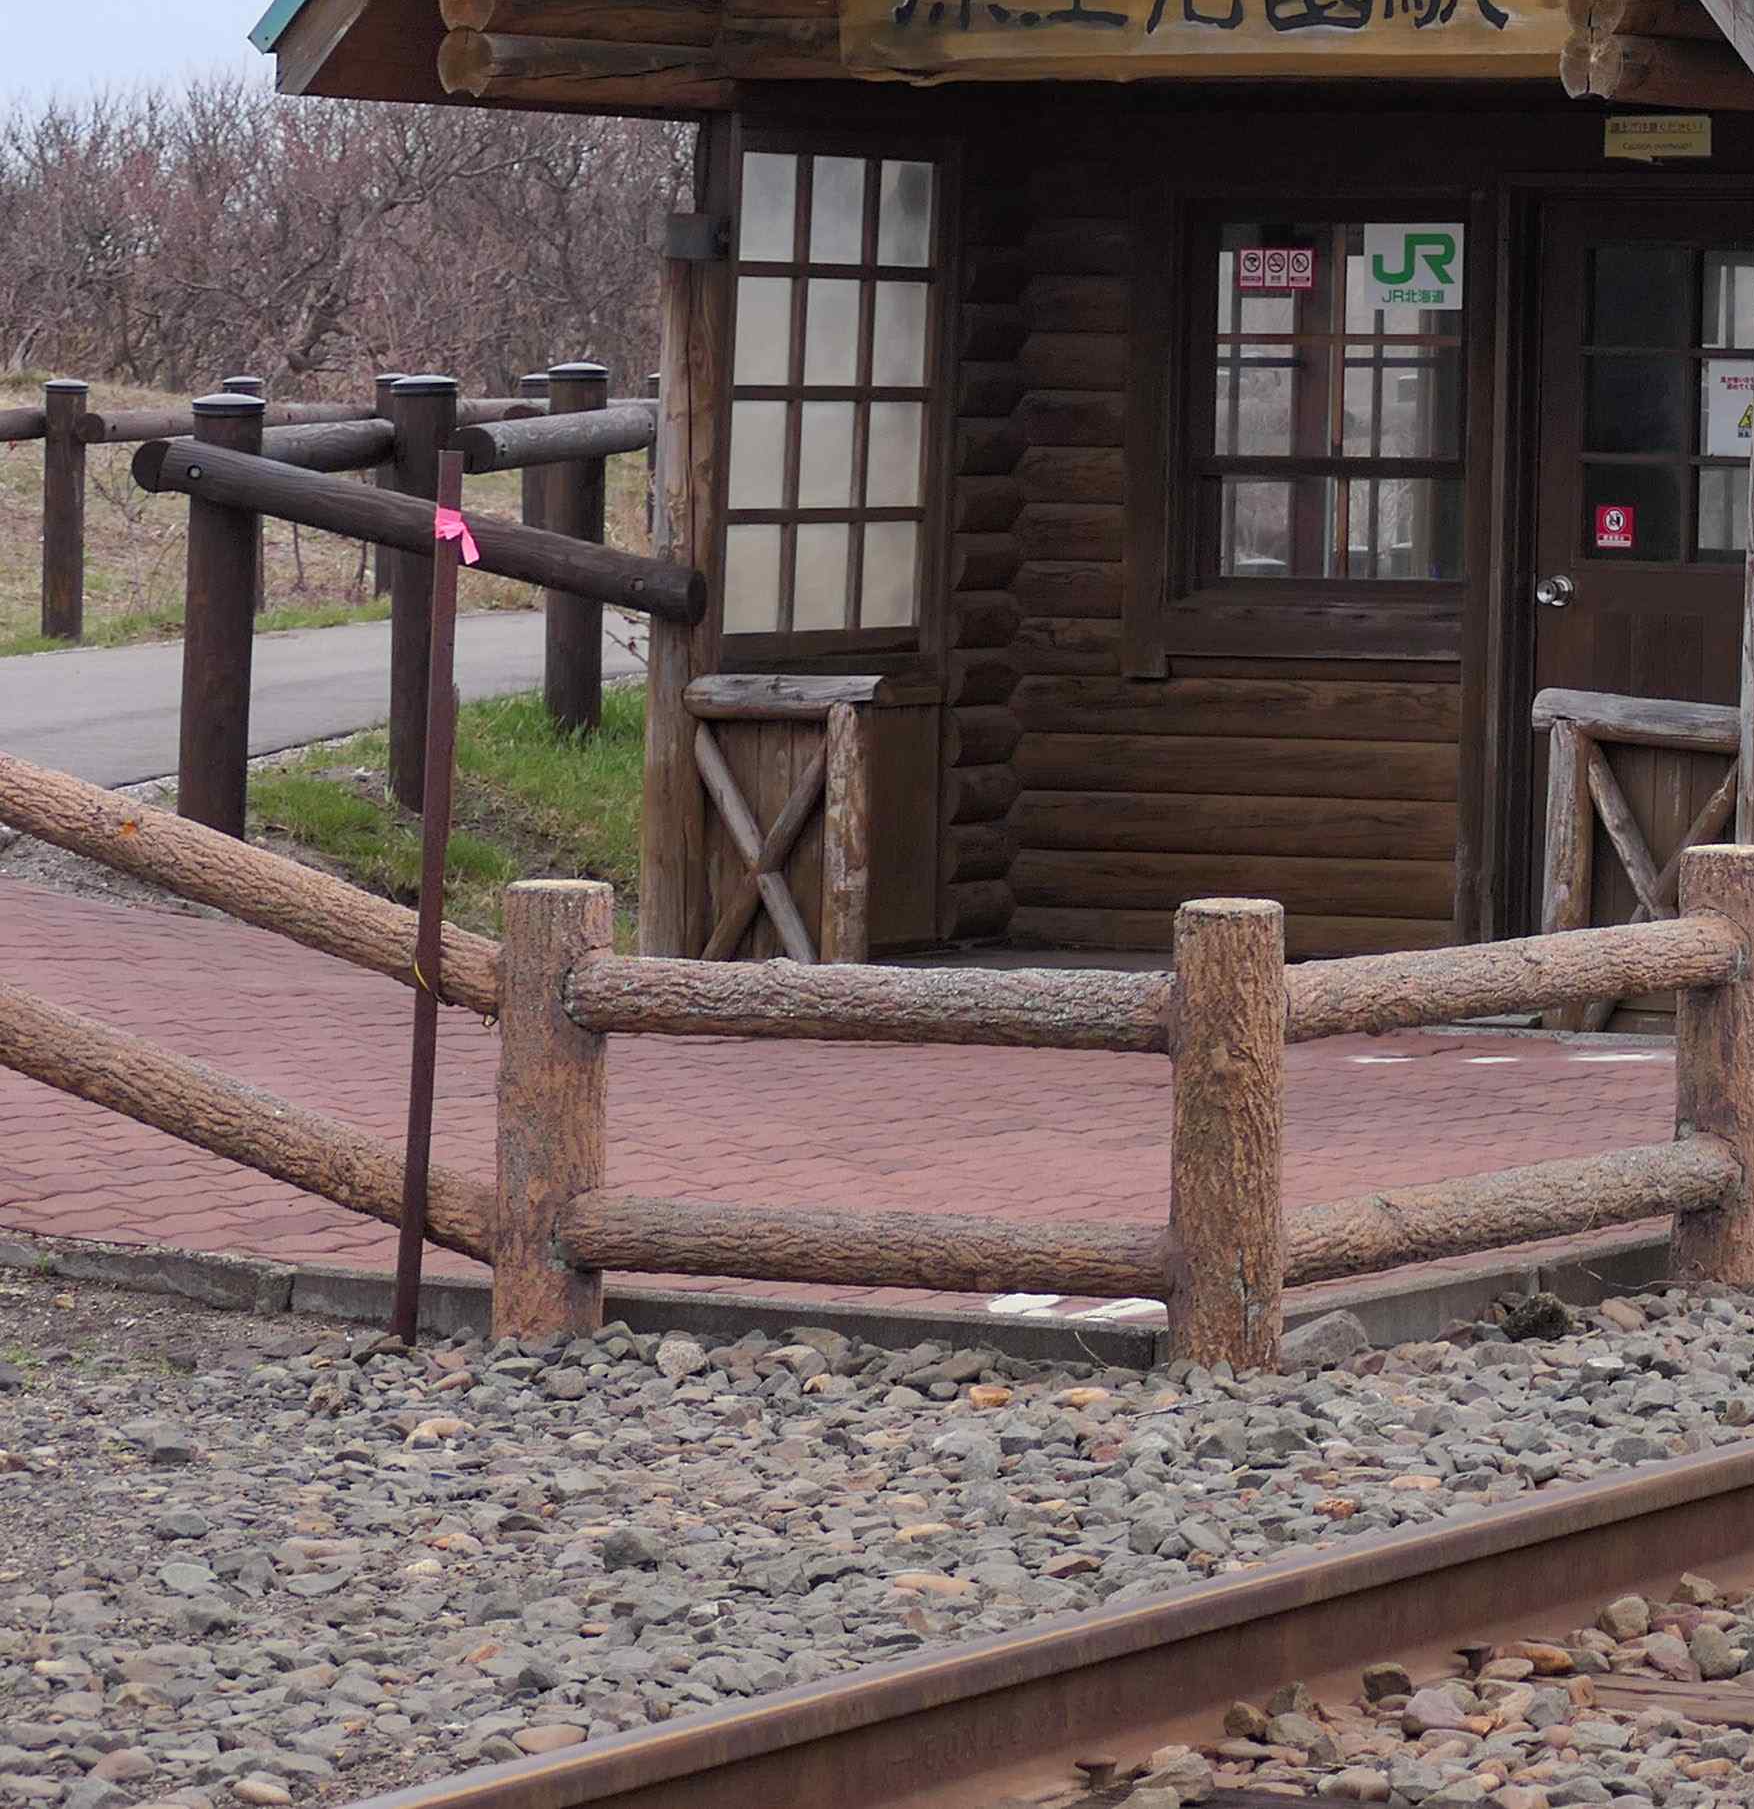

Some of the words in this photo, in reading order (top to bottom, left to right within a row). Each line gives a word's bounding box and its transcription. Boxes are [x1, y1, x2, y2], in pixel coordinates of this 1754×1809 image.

[1372, 233, 1456, 284] JR
[1382, 289, 1445, 303] JR北海道
